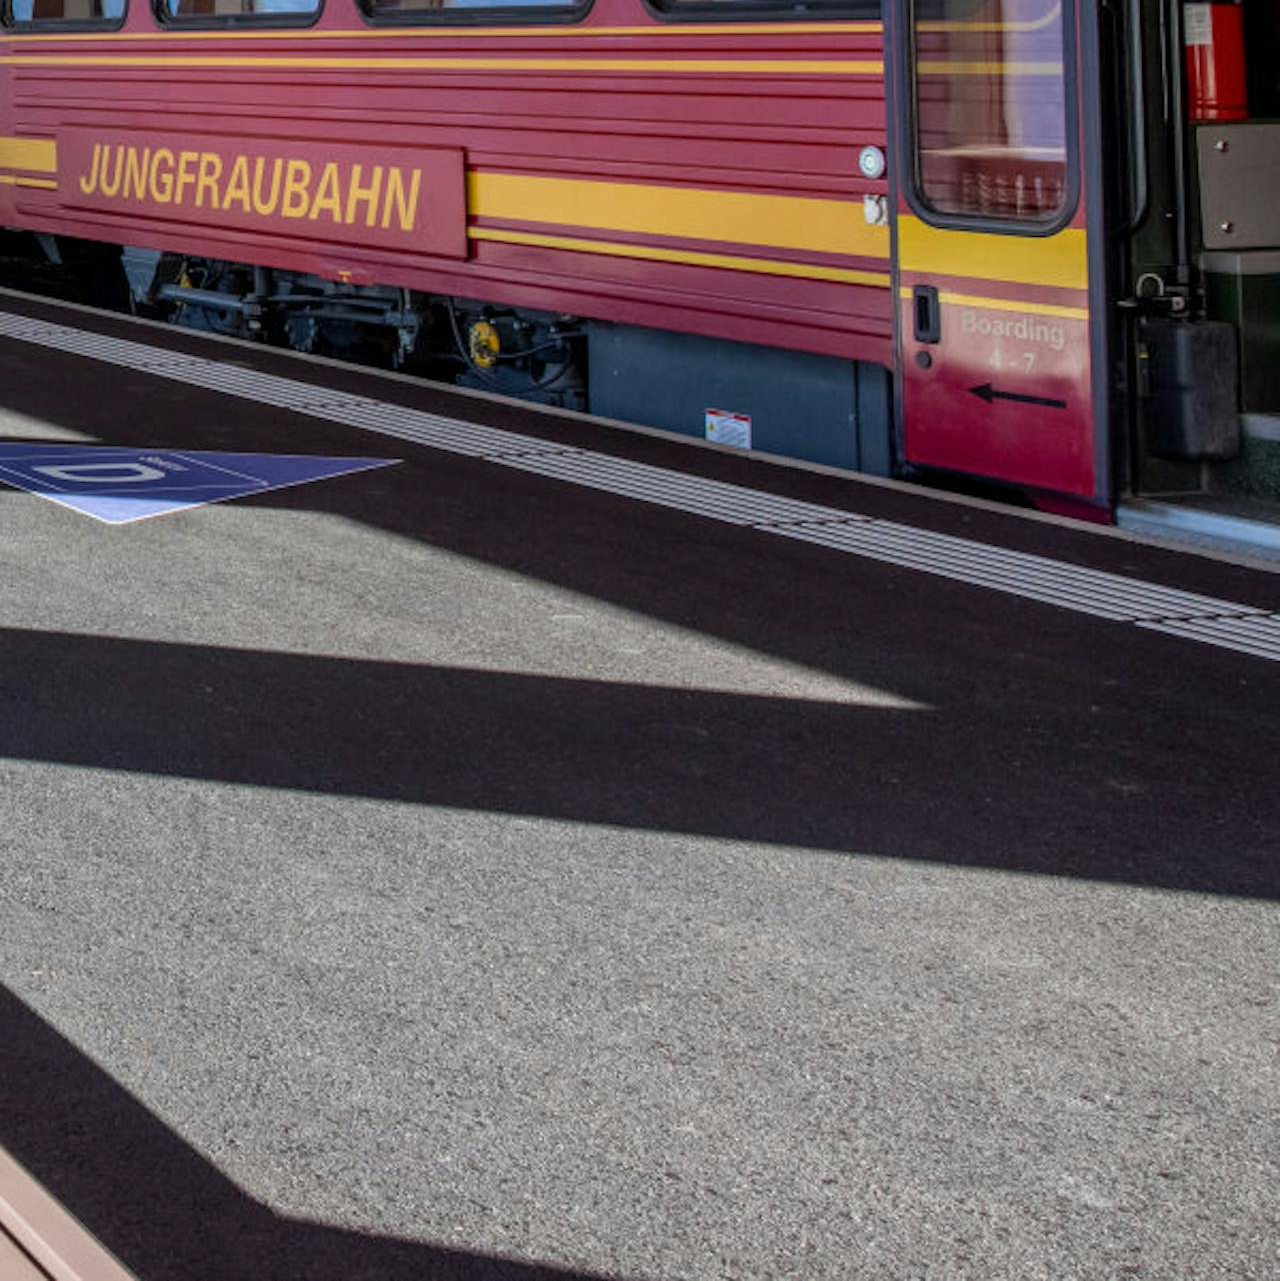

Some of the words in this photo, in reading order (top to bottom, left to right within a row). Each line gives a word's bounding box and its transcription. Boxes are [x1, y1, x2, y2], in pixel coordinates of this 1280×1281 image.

[80, 143, 422, 232] JUNGFRAUBAHN
[962, 311, 1065, 351] Boarding
[1023, 351, 1037, 375] 7
